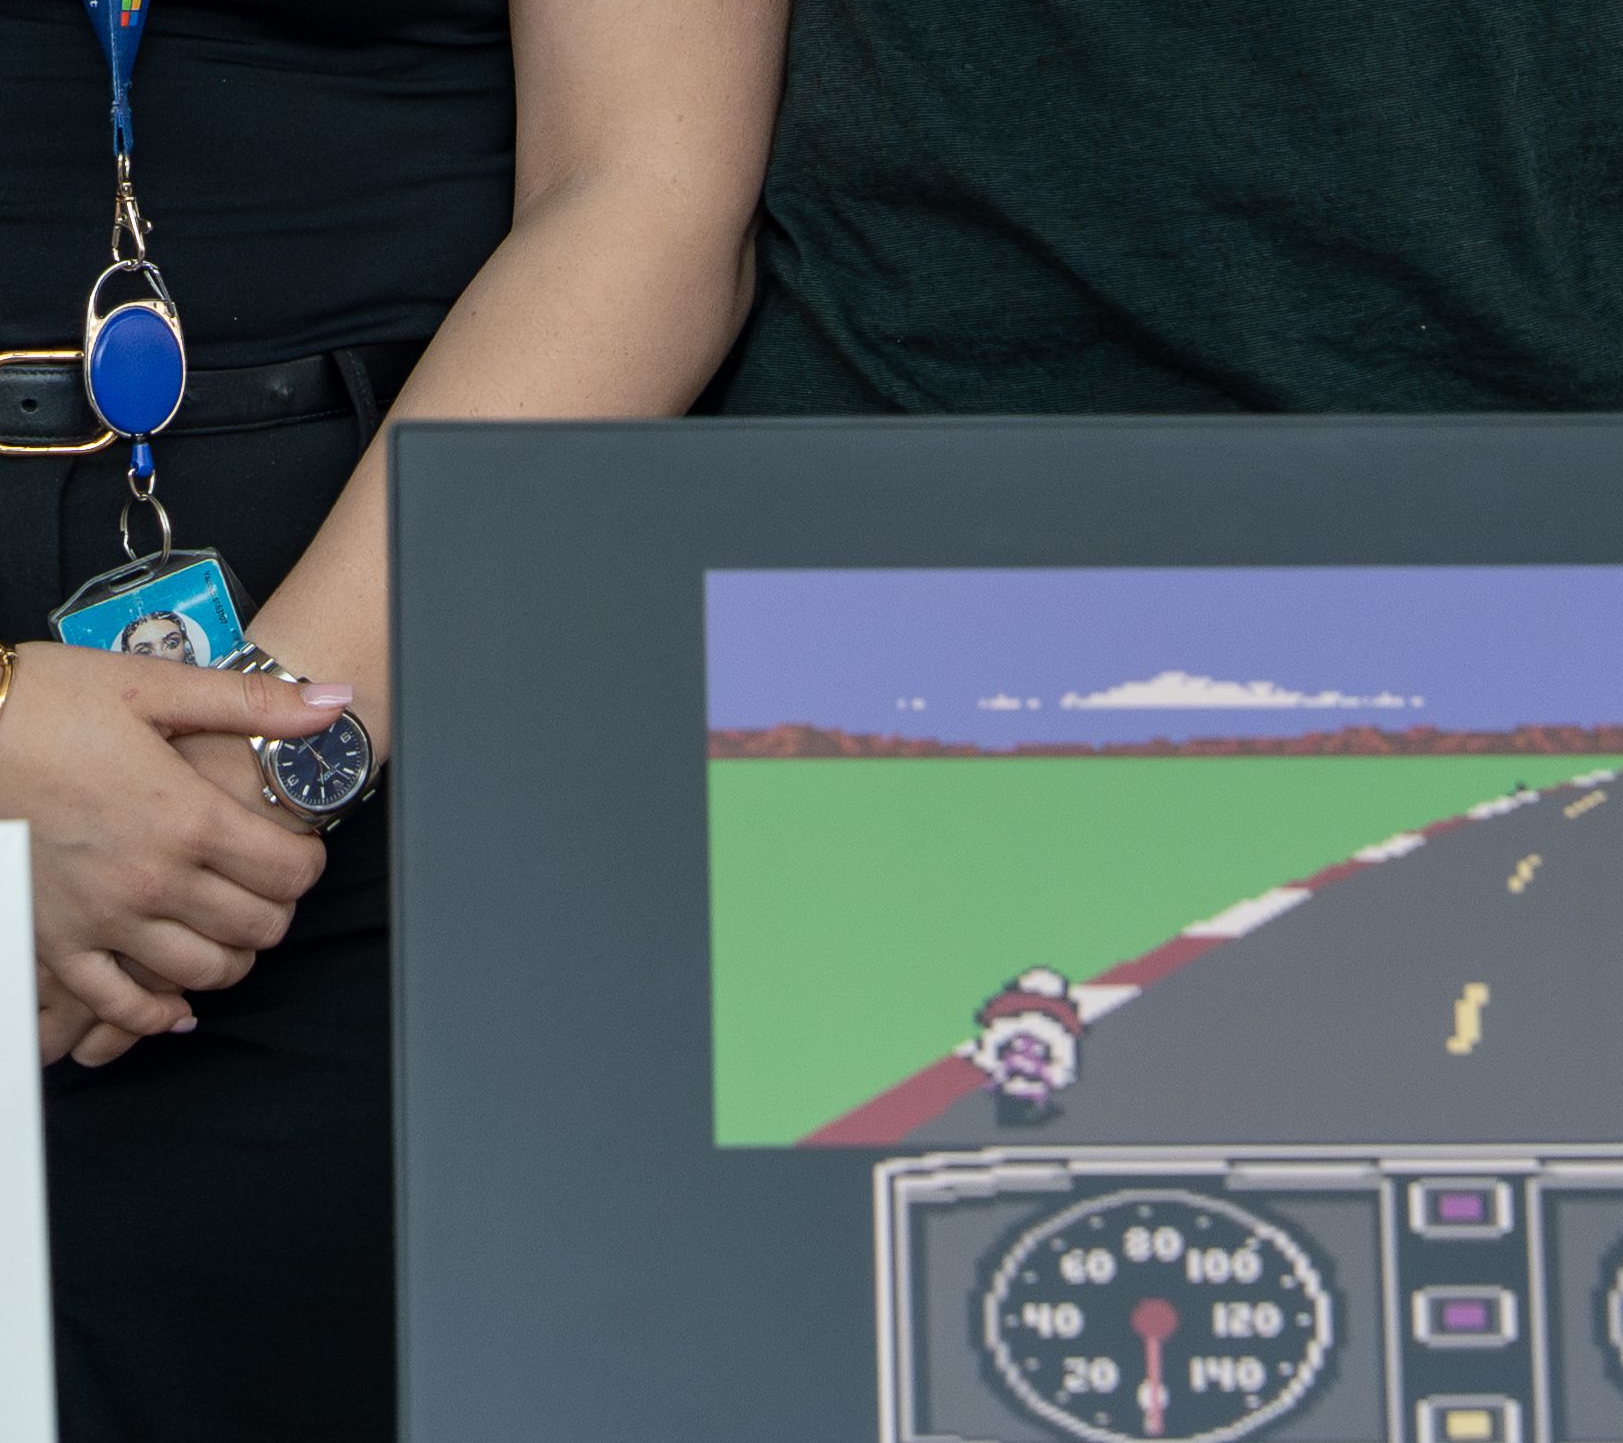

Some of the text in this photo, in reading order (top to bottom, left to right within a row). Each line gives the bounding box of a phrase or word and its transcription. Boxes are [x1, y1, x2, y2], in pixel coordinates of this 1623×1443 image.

[1122, 1225, 1183, 1263] 80
[1060, 1248, 1115, 1284] 60
[1186, 1247, 1262, 1285] 100
[1020, 1302, 1083, 1339] 40
[1211, 1302, 1283, 1338] 120
[1063, 1356, 1119, 1393] 20
[1188, 1356, 1266, 1393] 140
